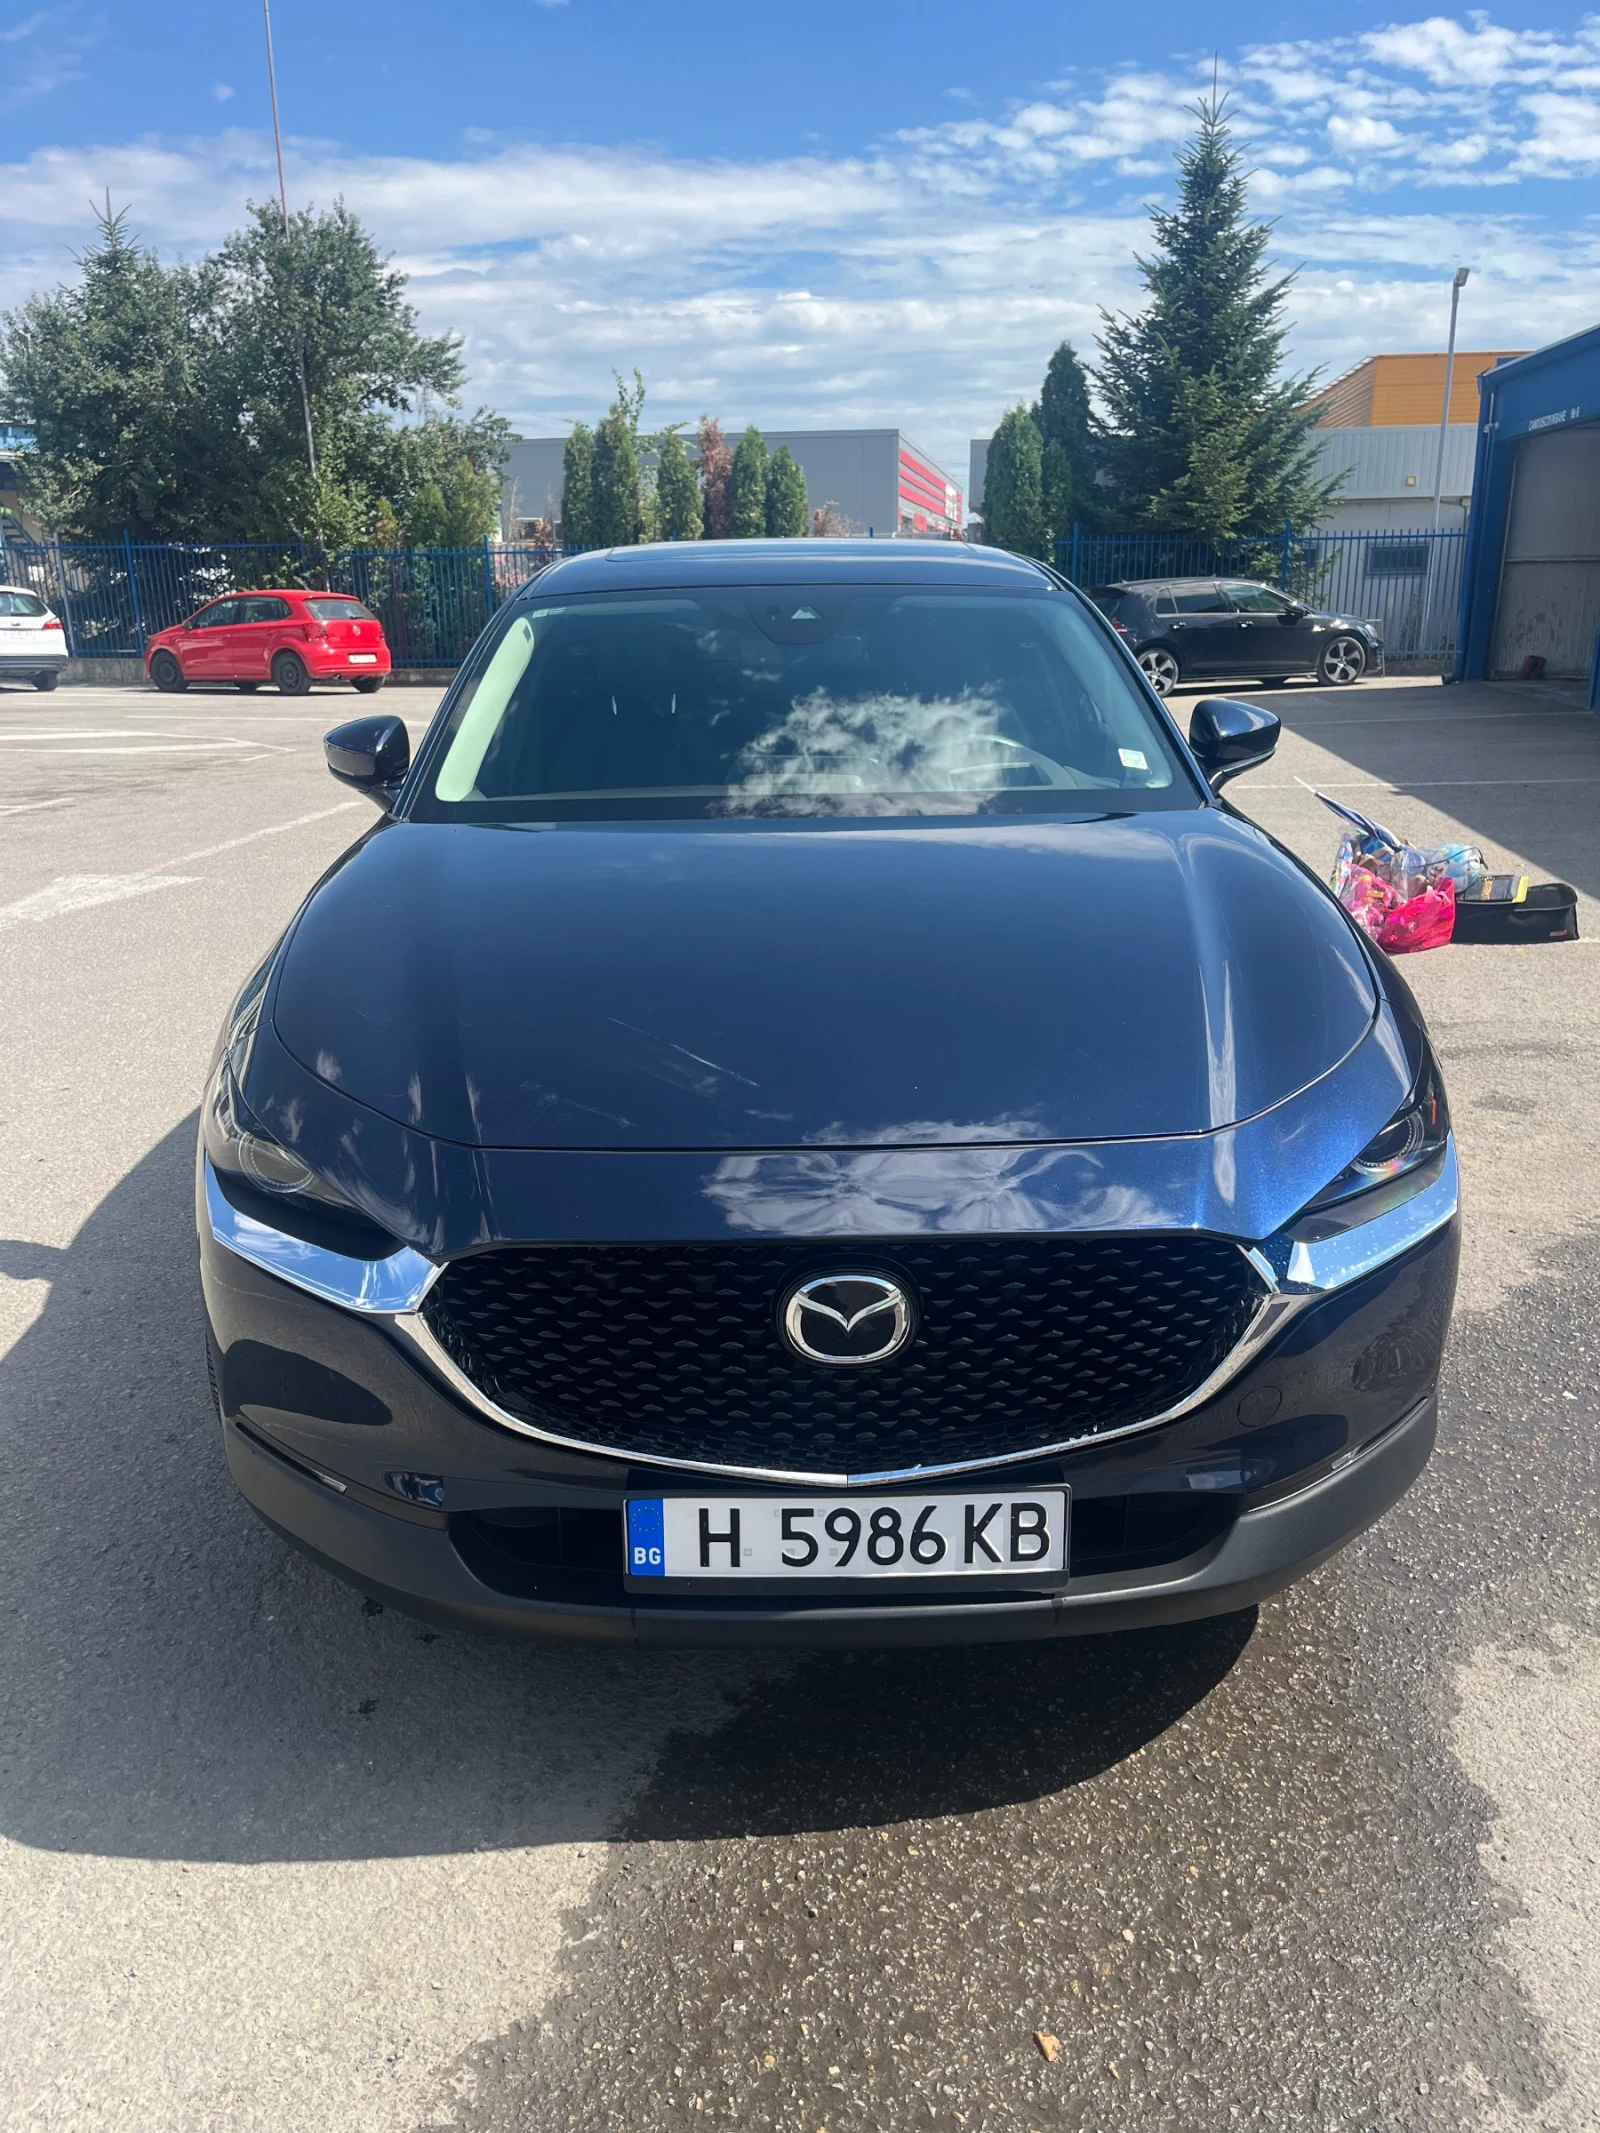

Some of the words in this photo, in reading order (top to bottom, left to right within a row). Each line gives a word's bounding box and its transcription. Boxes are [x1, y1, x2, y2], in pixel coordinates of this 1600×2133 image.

[633, 1547, 661, 1565] BG
[699, 1508, 740, 1567] H
[781, 1507, 946, 1568] 5986
[964, 1502, 1051, 1563] KB
